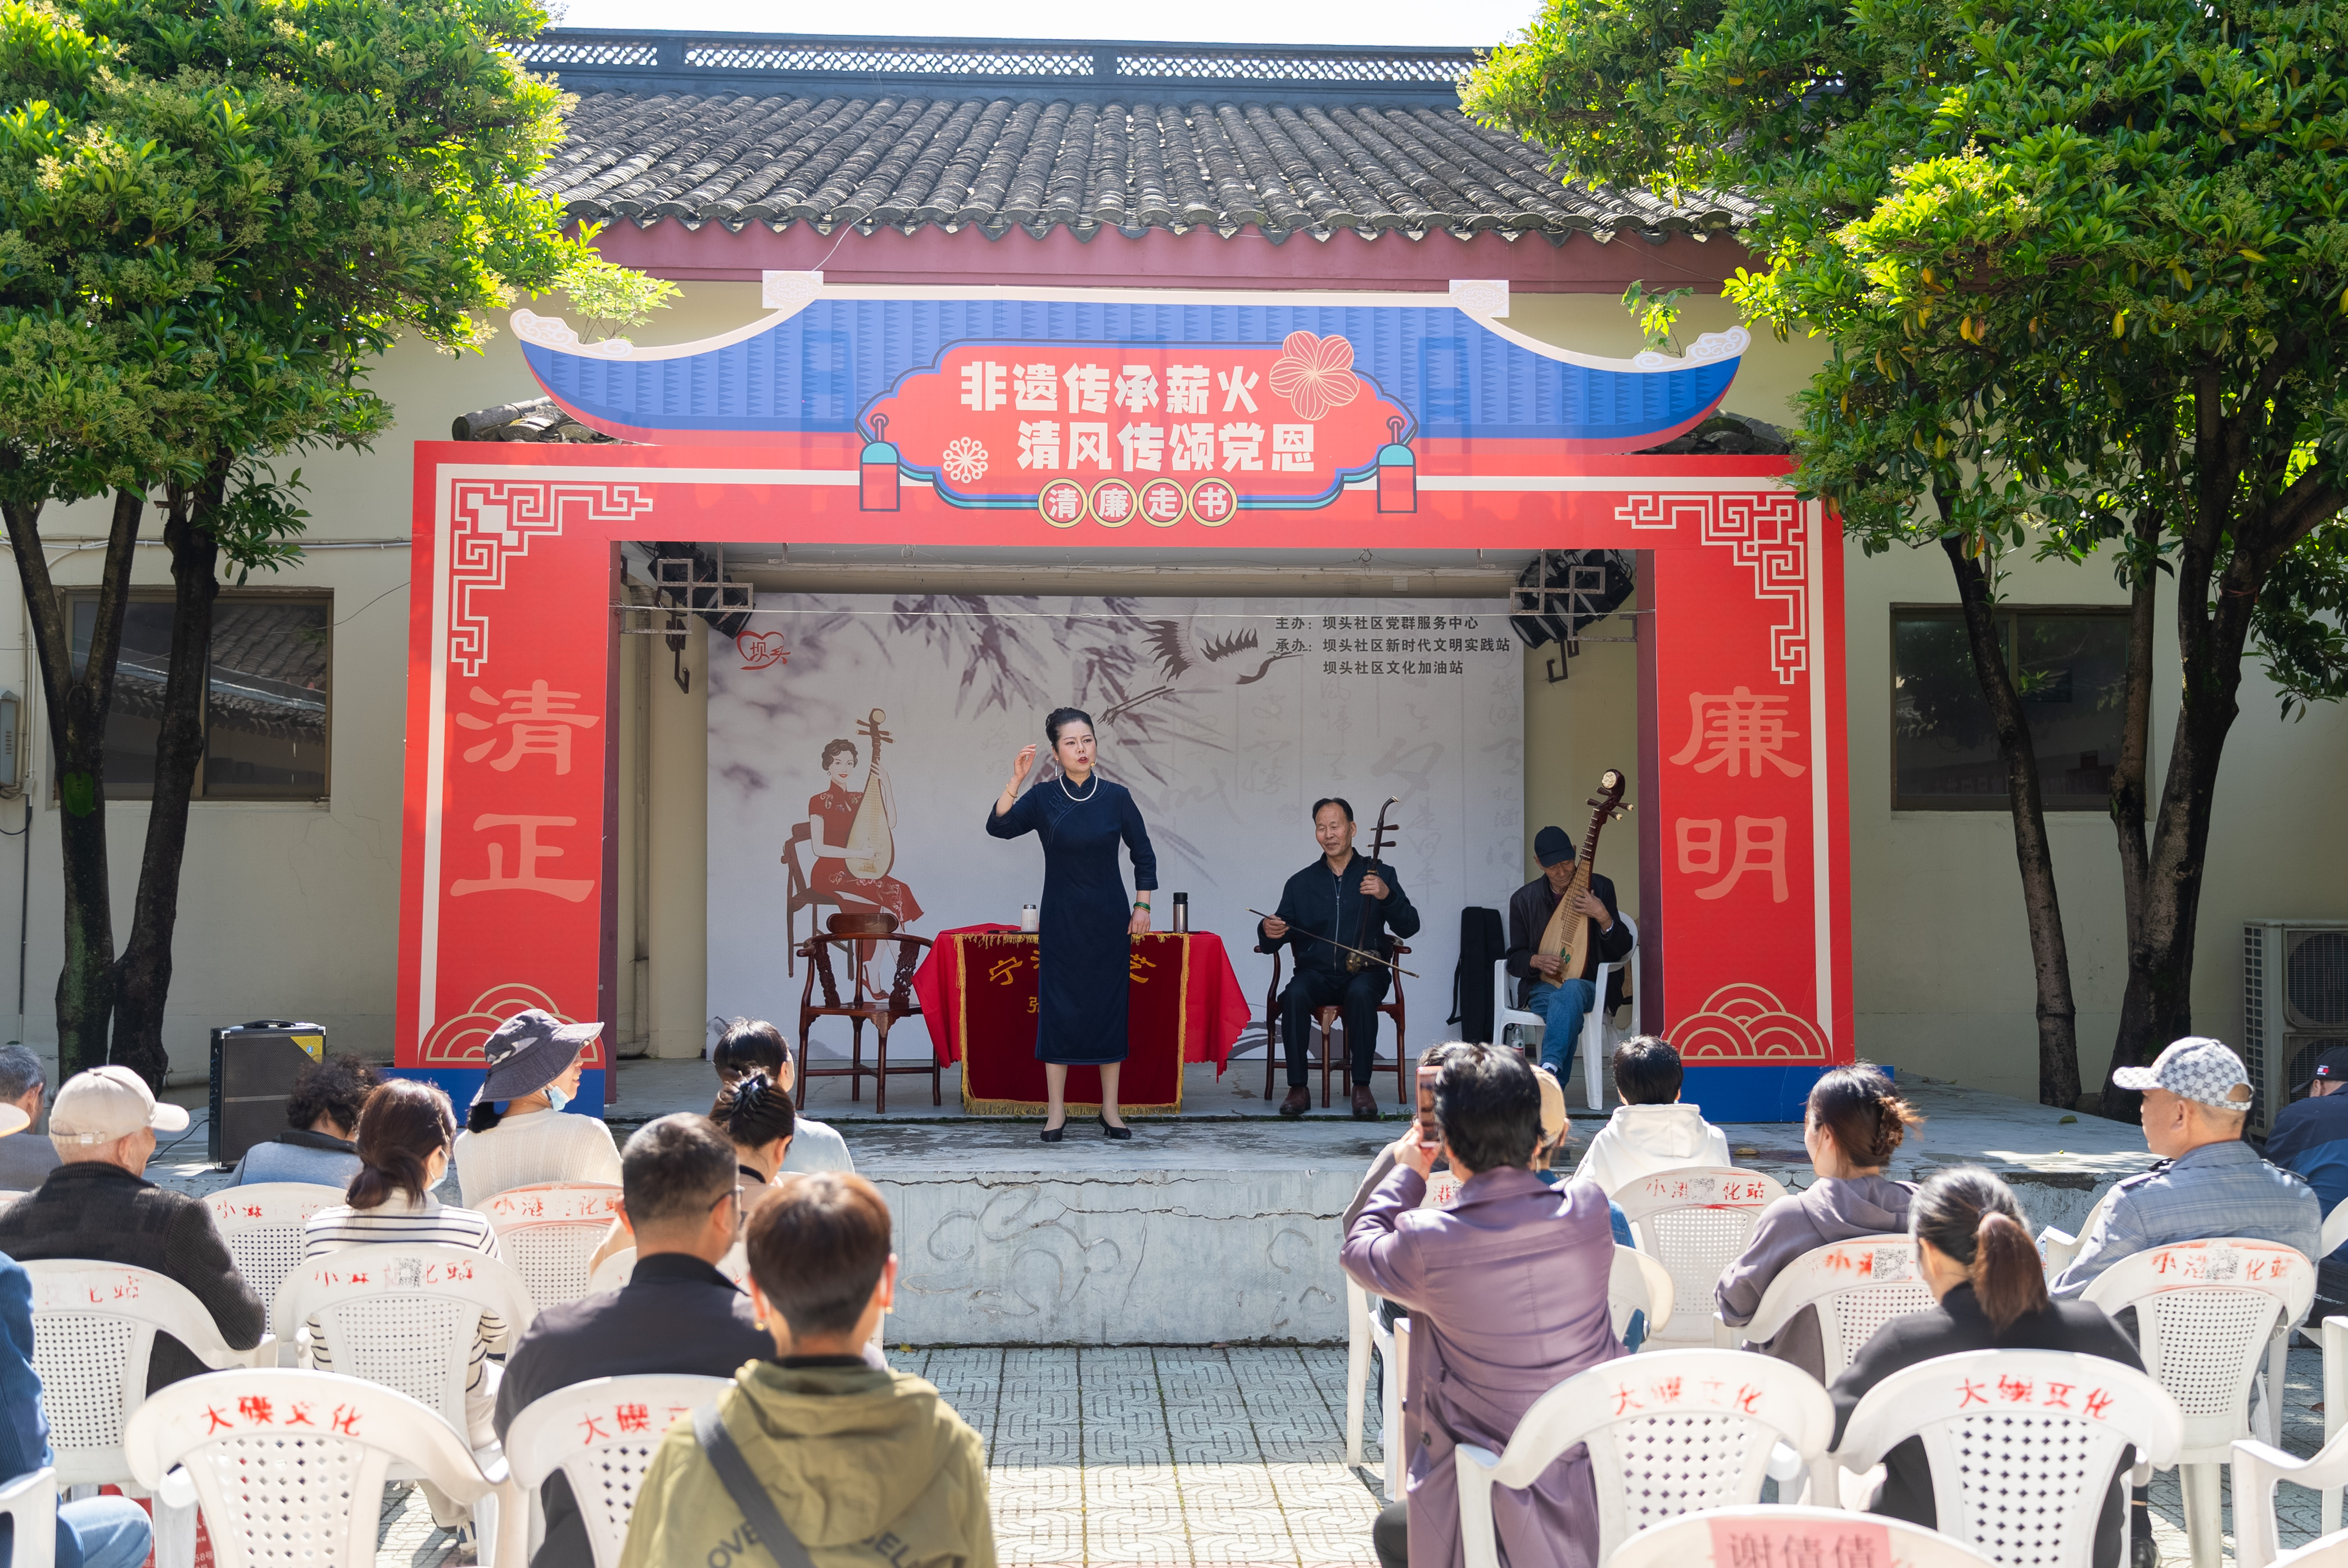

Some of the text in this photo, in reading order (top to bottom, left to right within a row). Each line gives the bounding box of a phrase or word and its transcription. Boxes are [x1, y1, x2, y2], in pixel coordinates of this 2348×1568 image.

[960, 361, 1260, 415] 非遗传承薪火
[1016, 420, 1315, 474] 清风传颂党恩
[1048, 487, 1228, 519] 清廉走书
[1323, 660, 1464, 675] 坝头社区文化加油站
[450, 679, 601, 903] 清正
[1668, 686, 1807, 903] 廉明
[1646, 1179, 1765, 1200] 小港化站
[2152, 1252, 2296, 1281] 小港化站
